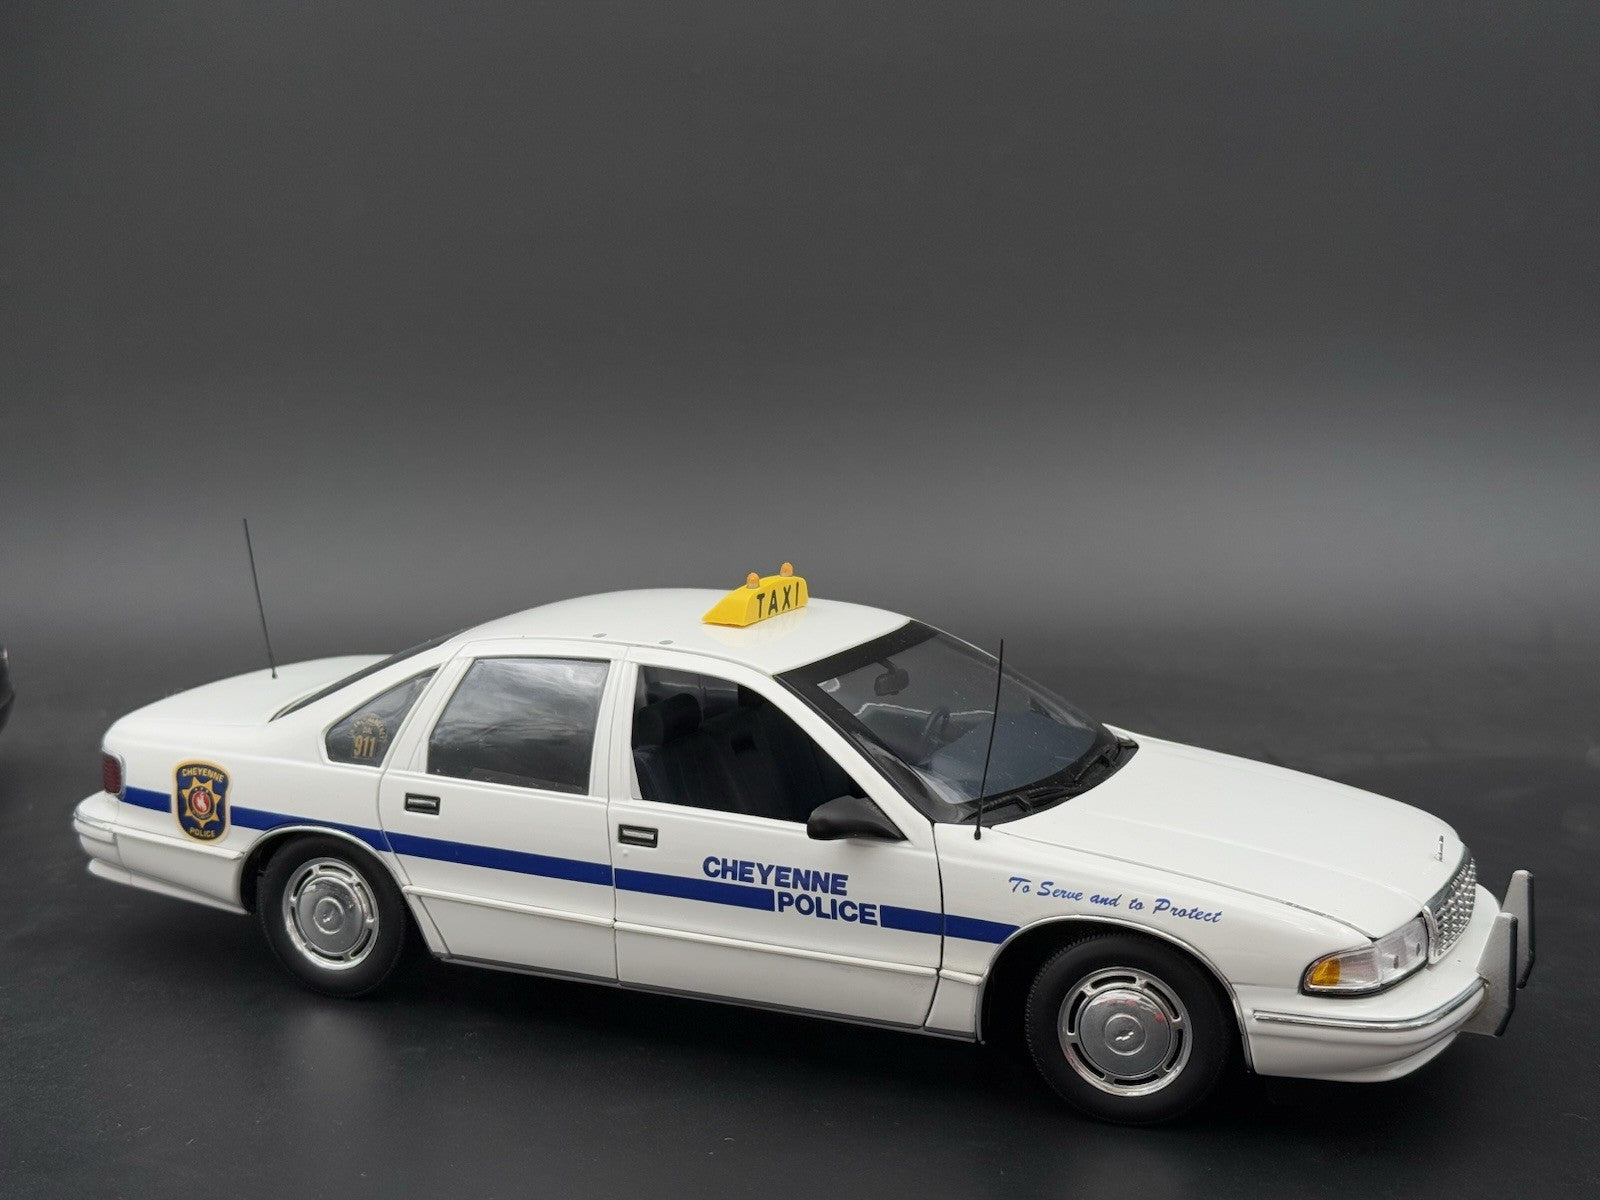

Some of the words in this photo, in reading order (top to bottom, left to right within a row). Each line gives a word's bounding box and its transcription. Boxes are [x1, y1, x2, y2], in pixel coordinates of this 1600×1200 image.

[756, 581, 799, 619] TAXI
[353, 734, 376, 758] 911
[182, 767, 225, 783] CHEYENNE
[189, 826, 216, 838] POLICE
[702, 856, 849, 896] CHEYENNE
[777, 891, 878, 926] POLICE
[1008, 876, 1031, 894] To
[1036, 881, 1083, 901] Serve
[1089, 894, 1123, 908] and
[1128, 897, 1145, 911] to
[1152, 898, 1223, 924] Protect
